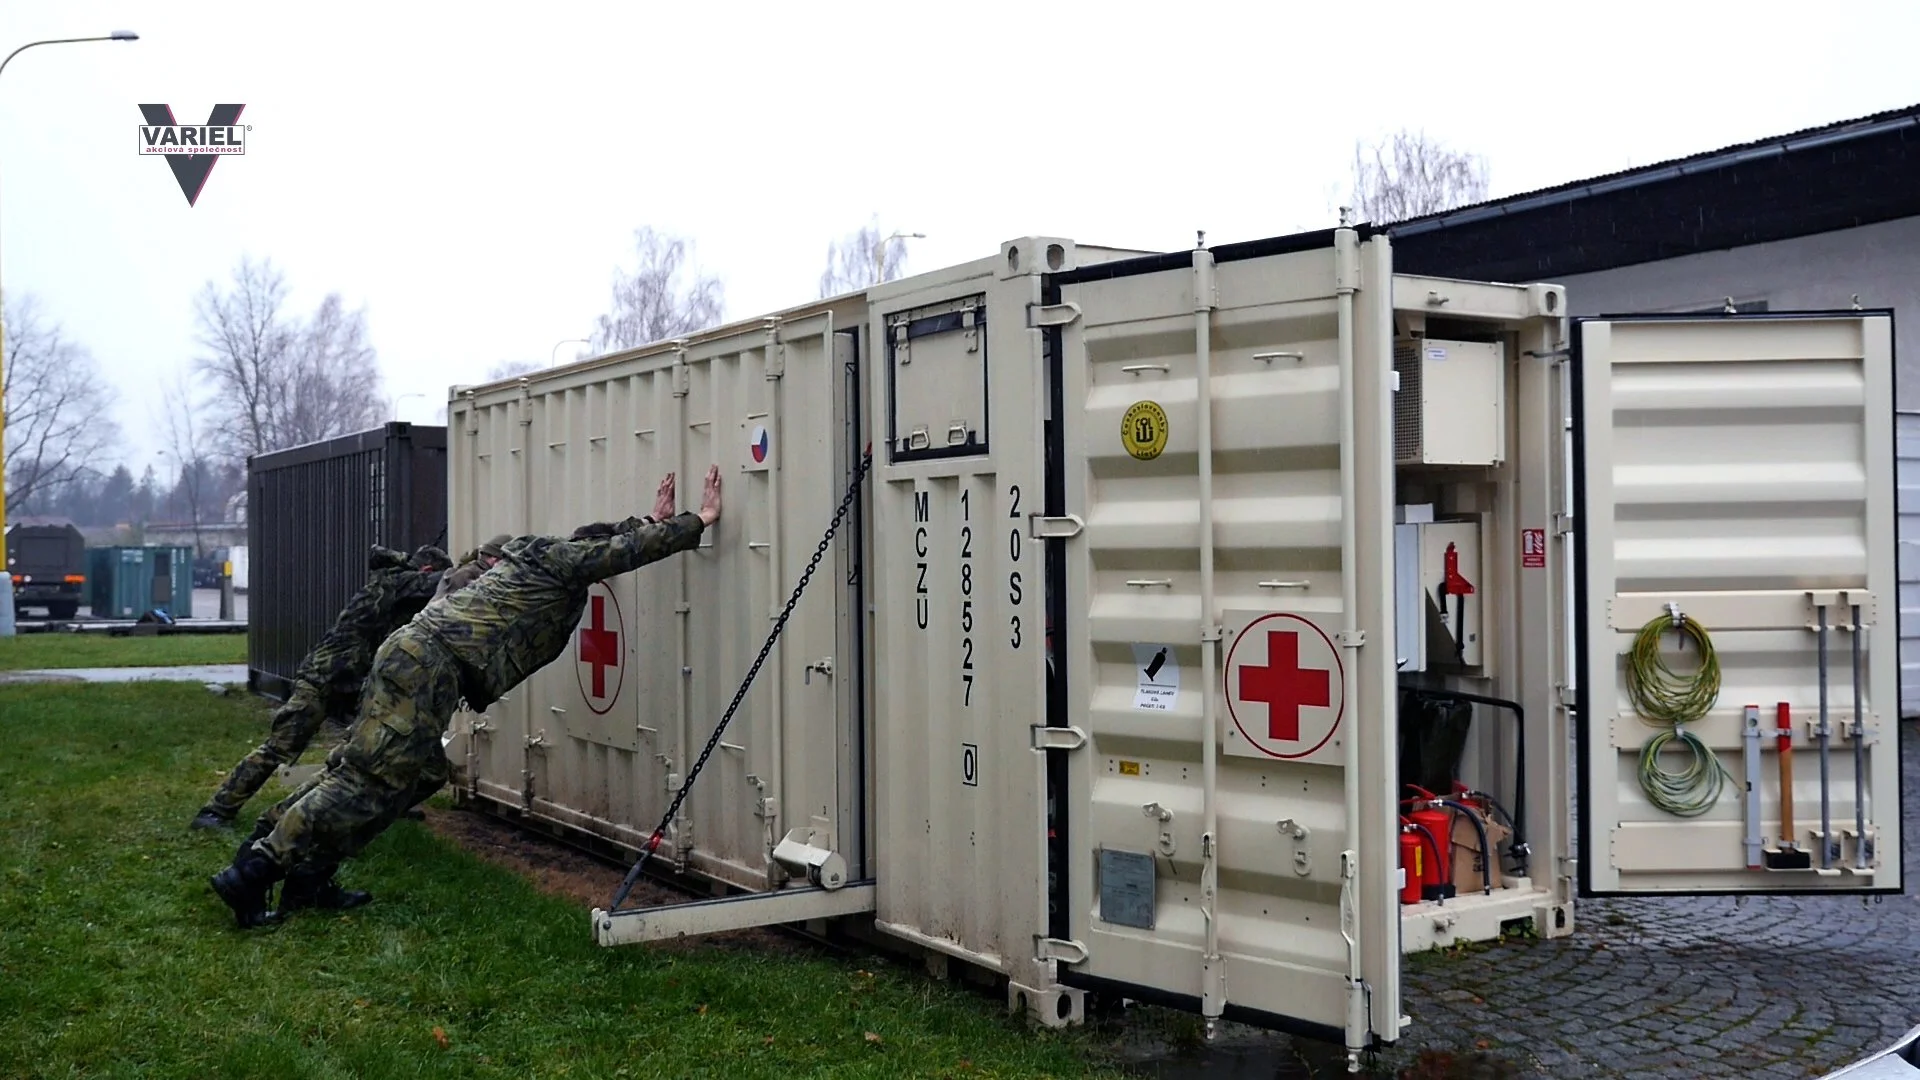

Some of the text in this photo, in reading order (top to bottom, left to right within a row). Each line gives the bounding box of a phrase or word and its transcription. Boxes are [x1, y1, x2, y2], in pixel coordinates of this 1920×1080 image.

[914, 491, 929, 629] MCZU
[961, 489, 973, 706] 128527
[1009, 485, 1022, 649] 20S3
